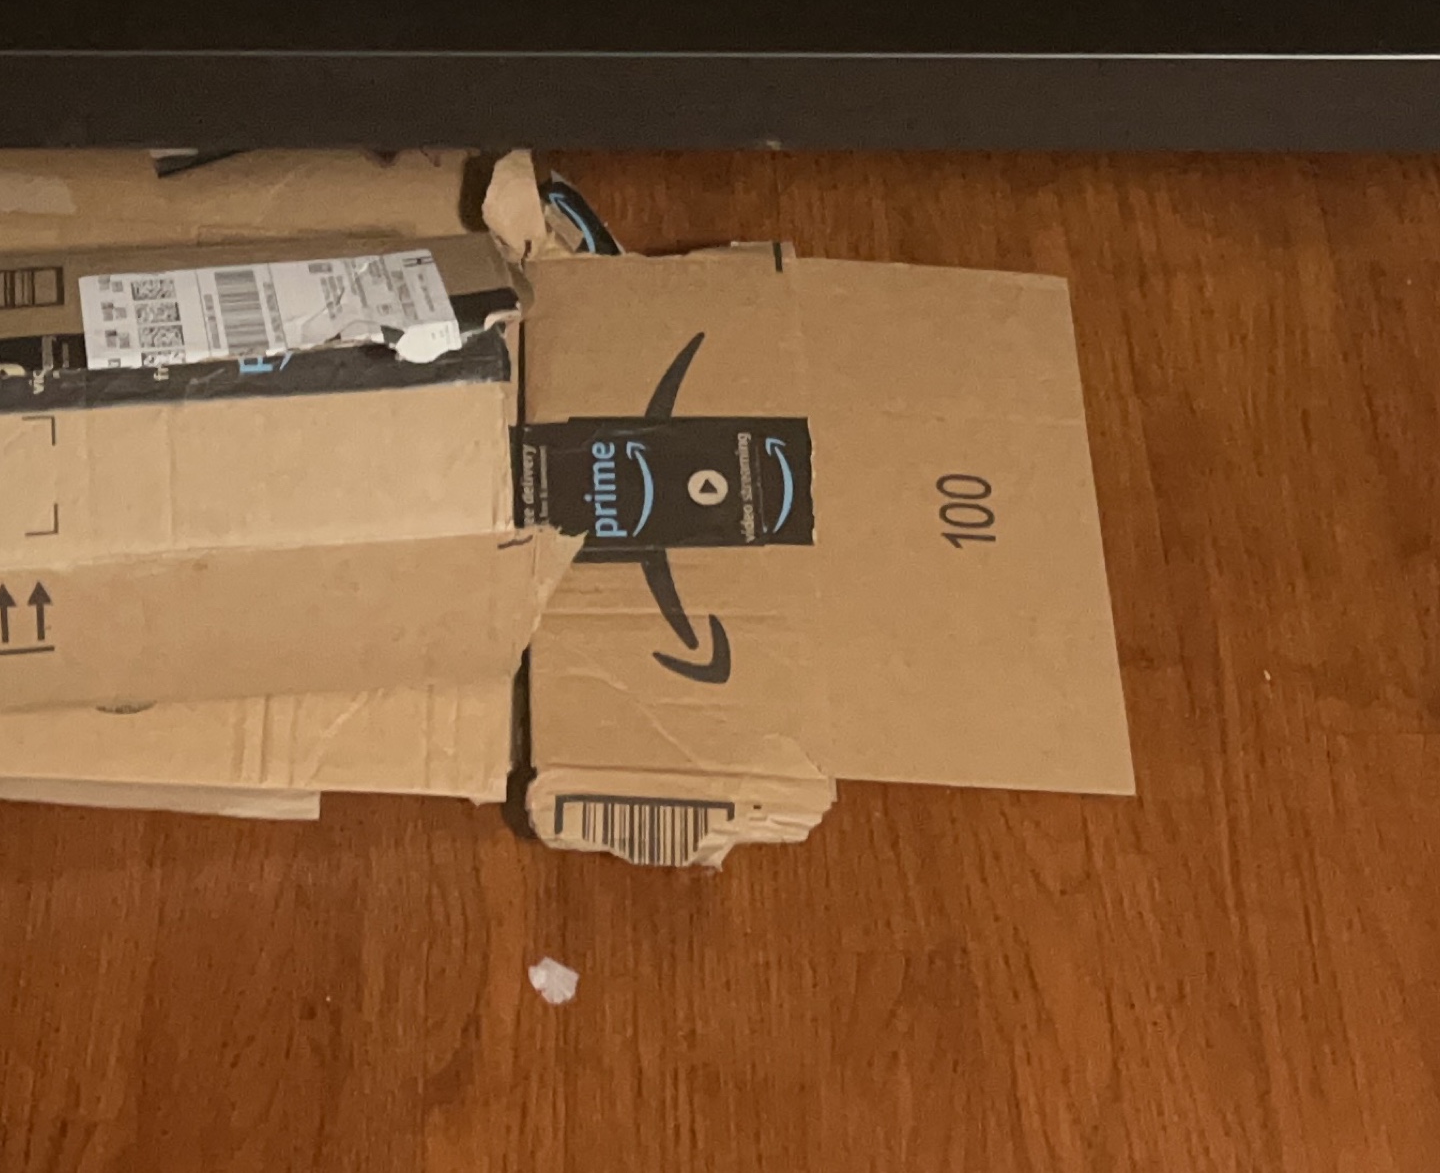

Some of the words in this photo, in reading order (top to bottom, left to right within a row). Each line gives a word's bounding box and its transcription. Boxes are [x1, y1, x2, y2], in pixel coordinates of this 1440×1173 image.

[521, 444, 537, 504] delivery
[583, 441, 628, 538] prime
[734, 432, 753, 501] streaming
[740, 504, 756, 543] video
[936, 474, 996, 549] 100
